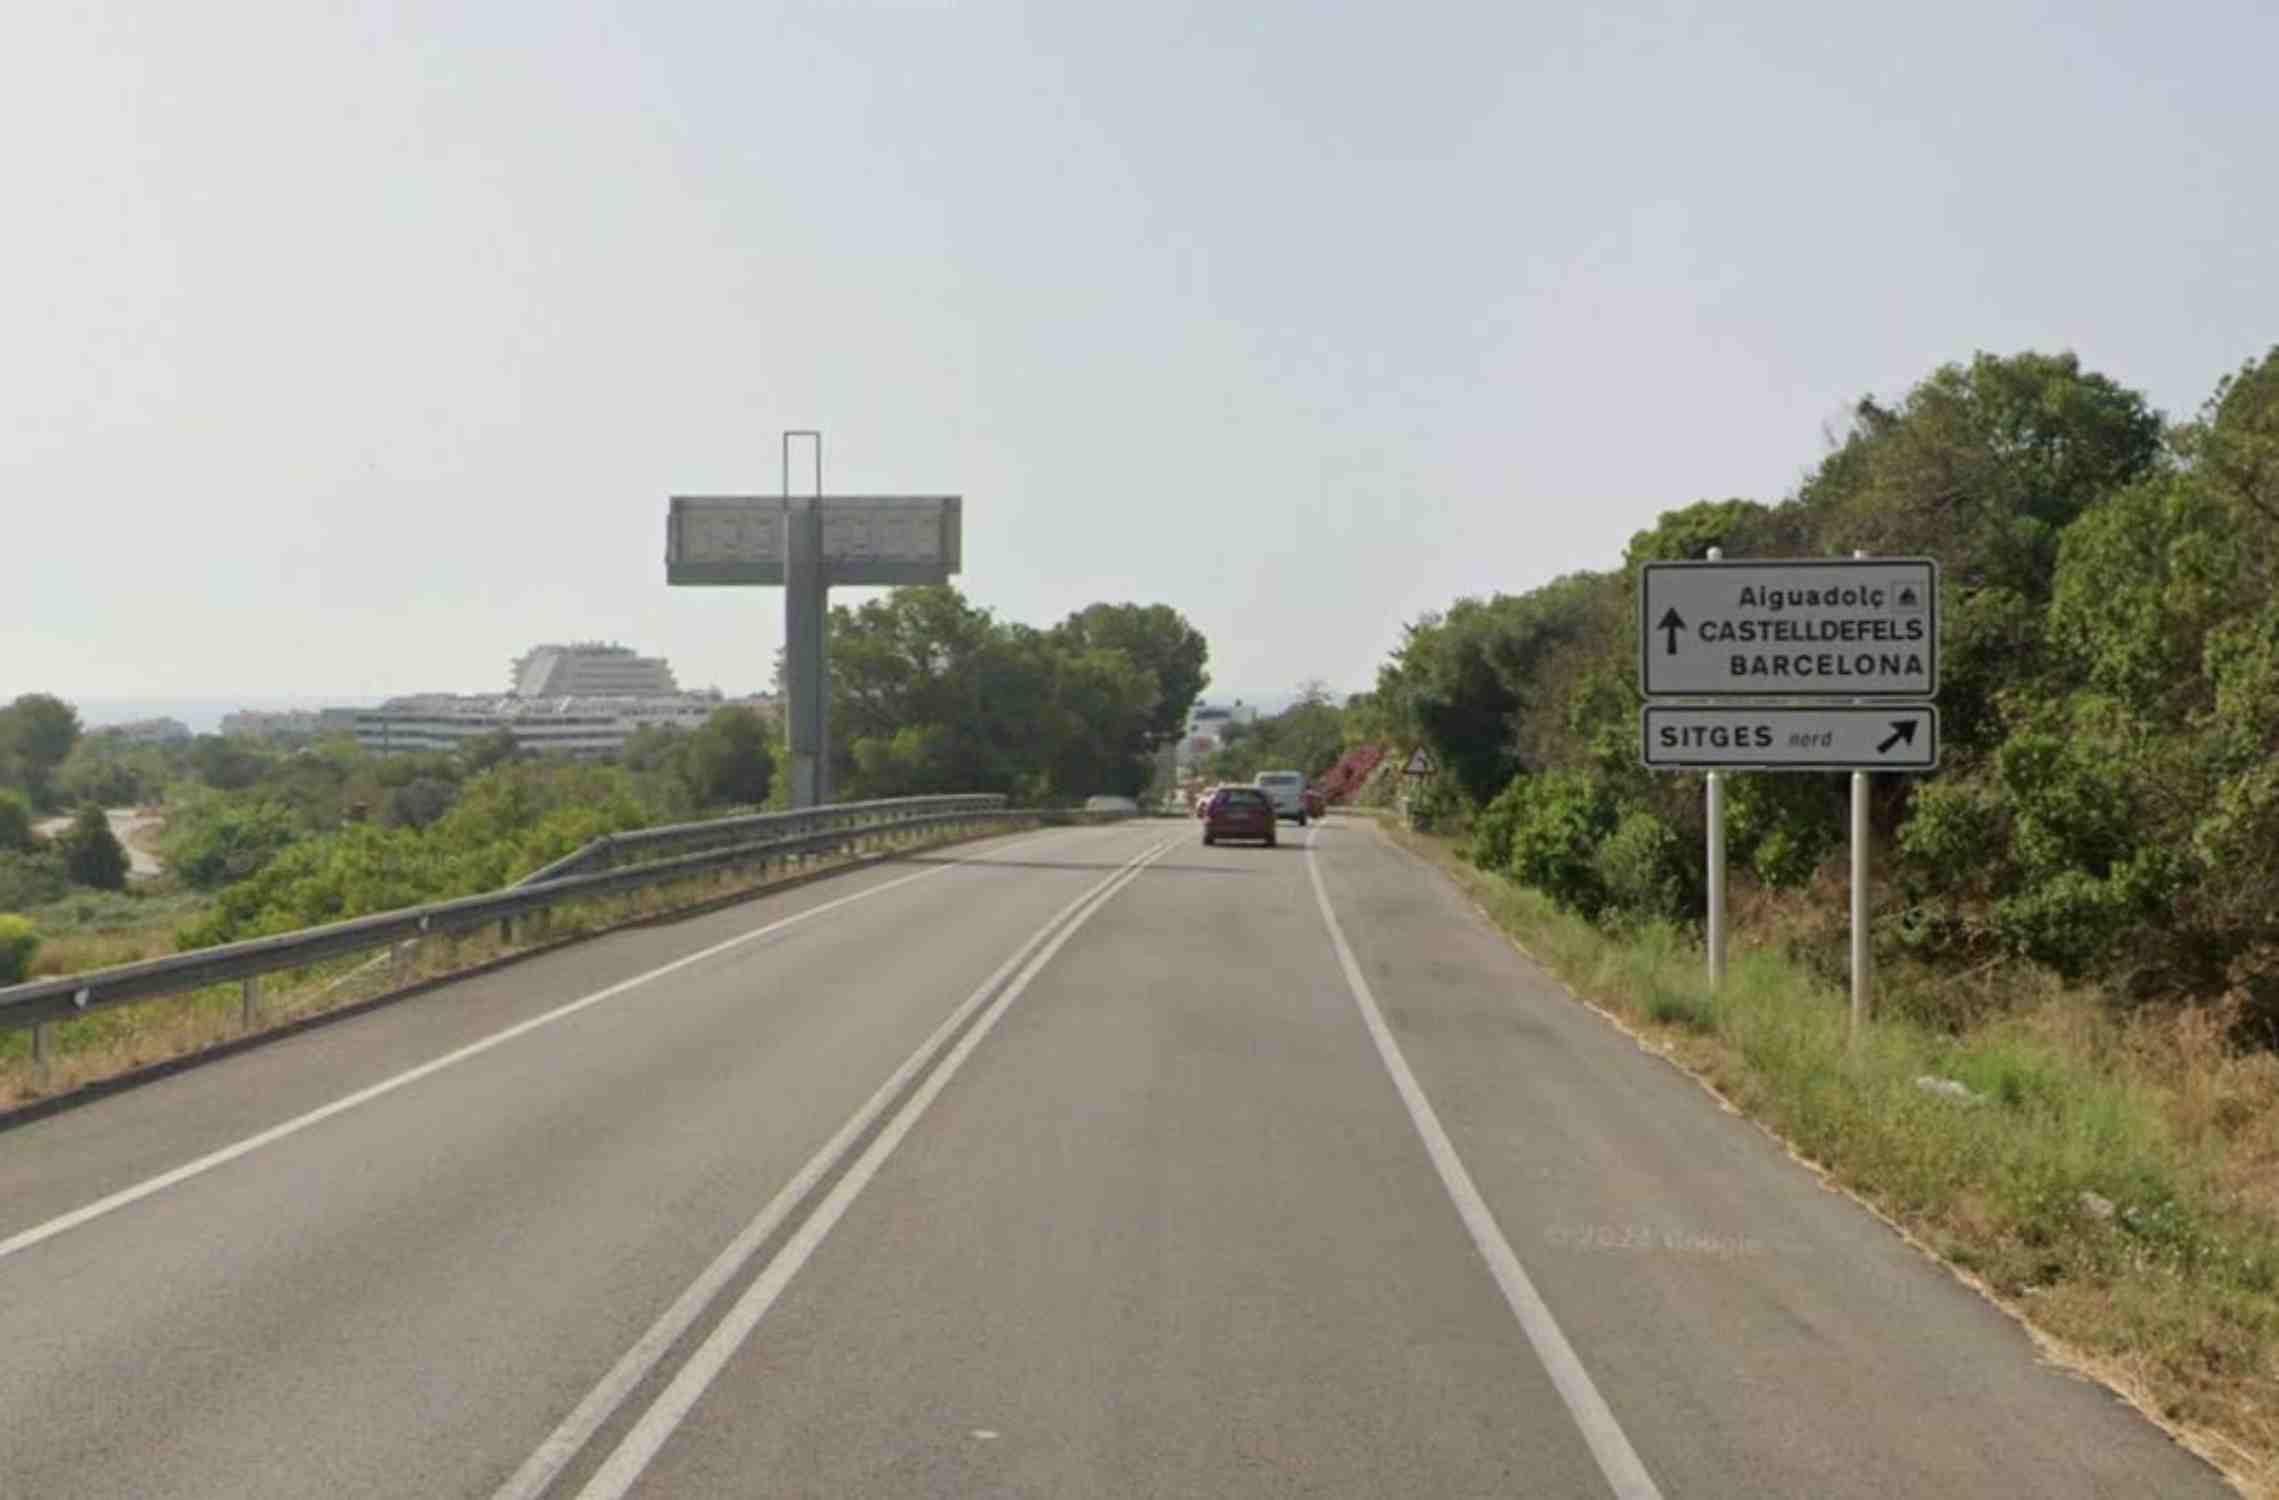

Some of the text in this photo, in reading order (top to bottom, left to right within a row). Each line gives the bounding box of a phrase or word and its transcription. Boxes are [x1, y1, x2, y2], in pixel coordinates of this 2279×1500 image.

[1739, 586, 1885, 611] Aiguadolç
[1699, 618, 1925, 643] CASTELLDEFELS
[1730, 653, 1924, 677] BARCELONA
[1659, 725, 1833, 749] SITGES nord
